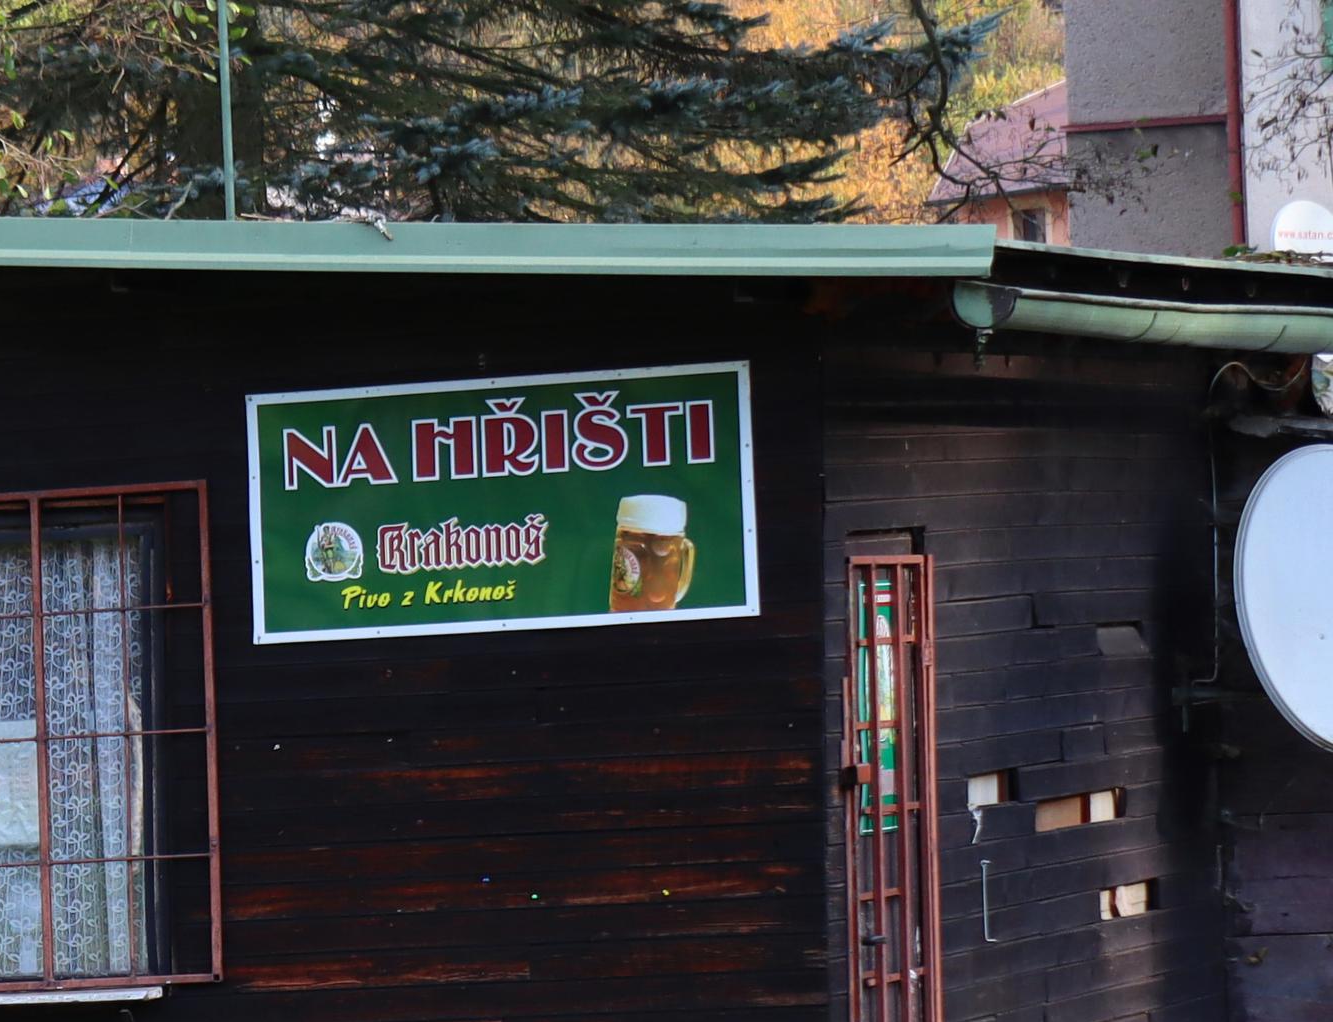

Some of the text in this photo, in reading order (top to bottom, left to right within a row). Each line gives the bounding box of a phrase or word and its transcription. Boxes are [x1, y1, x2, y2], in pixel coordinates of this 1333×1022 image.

[283, 391, 715, 491] NA HŘIŠTI
[376, 514, 549, 575] Krakonoš
[341, 579, 517, 609] Pivo z Krkonoš
